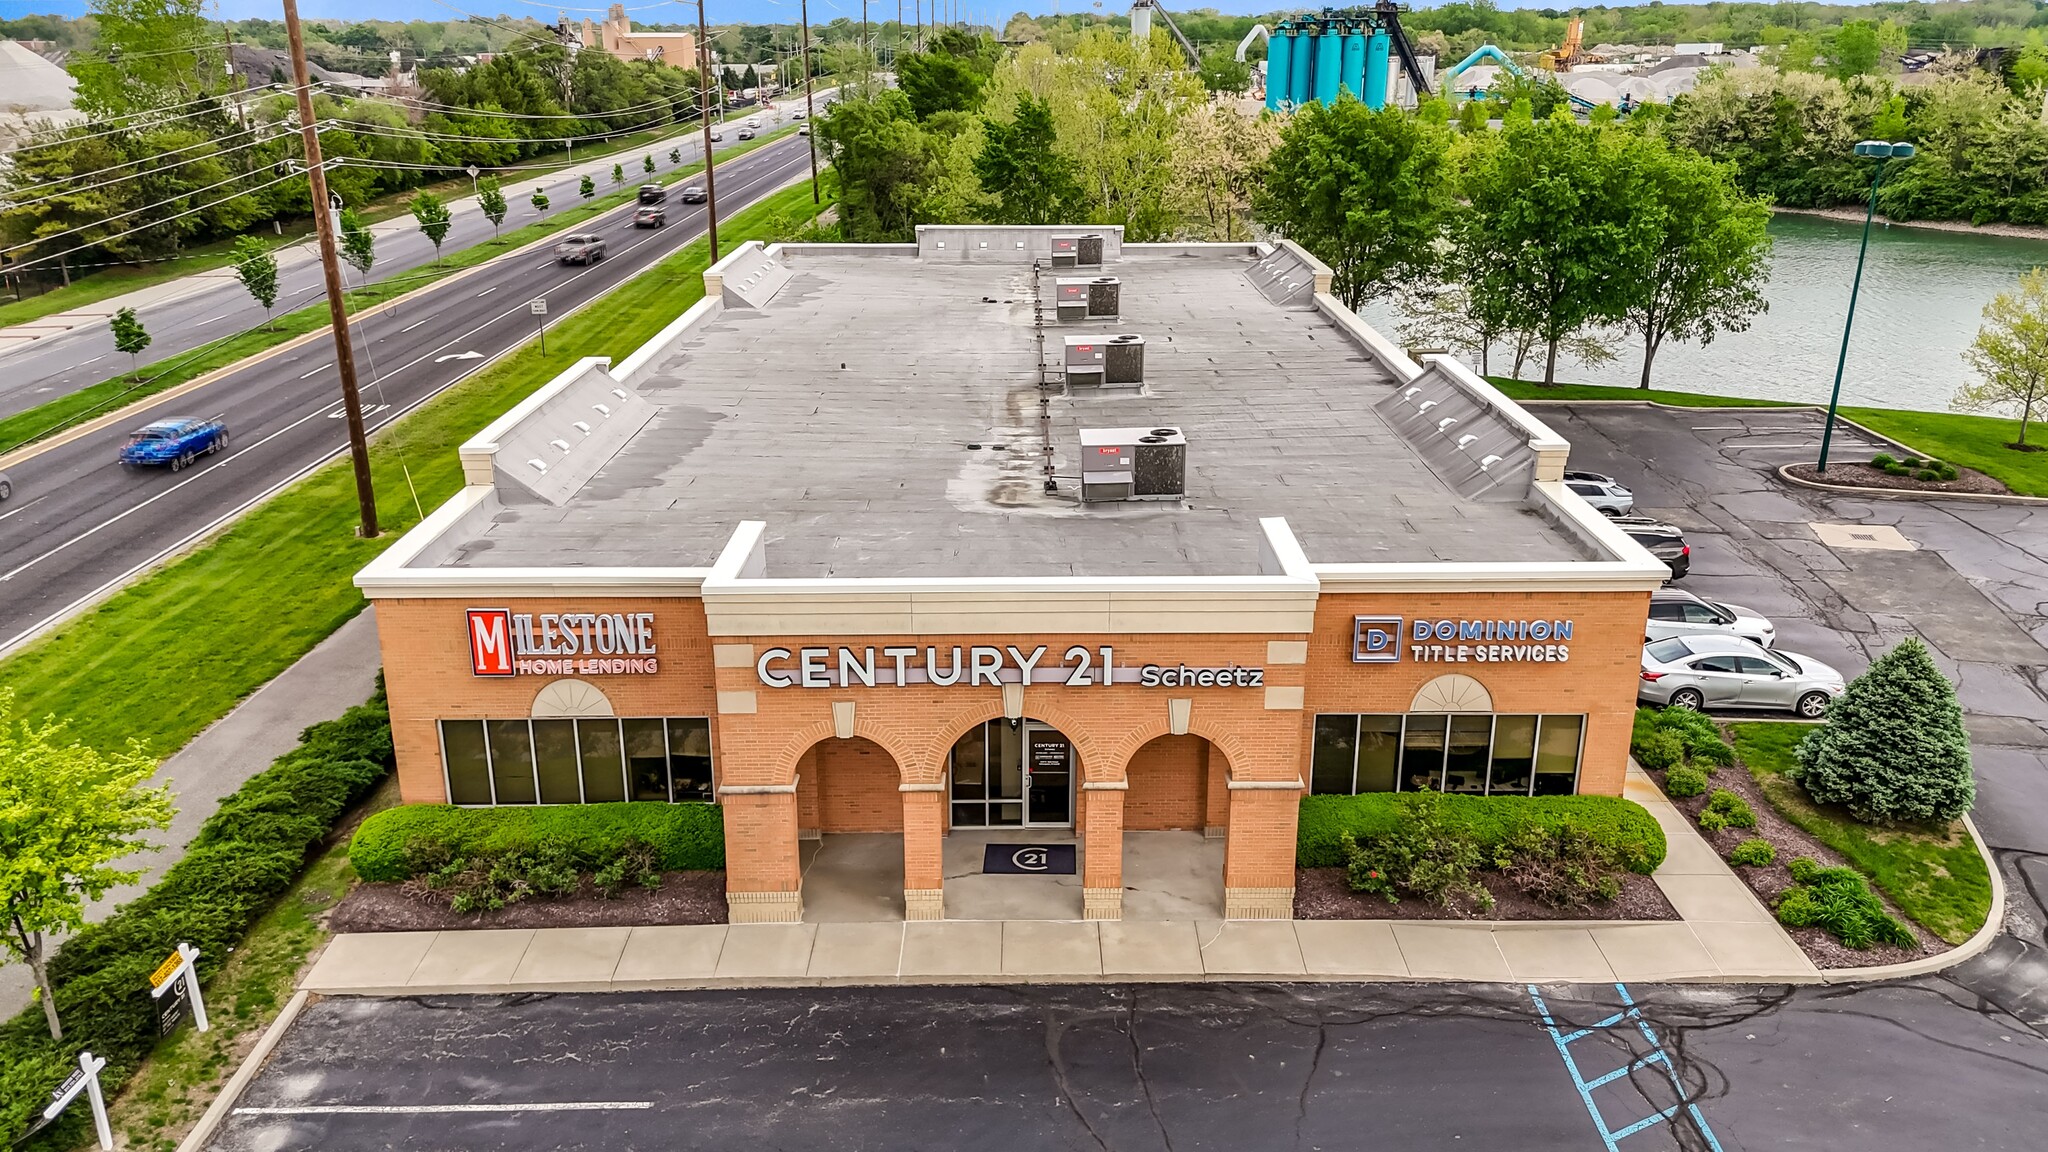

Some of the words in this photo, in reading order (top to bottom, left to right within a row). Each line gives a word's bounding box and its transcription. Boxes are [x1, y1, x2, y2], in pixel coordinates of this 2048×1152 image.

[1412, 619, 1574, 640] DOMINION
[471, 613, 656, 671] MILESTONE
[1411, 645, 1469, 662] TITLE
[1475, 644, 1570, 662] SERVICES
[519, 659, 575, 675] HOME
[579, 658, 658, 675] LENDING
[757, 646, 1047, 688] CENTURY
[1064, 645, 1113, 686] 21
[1140, 663, 1264, 687] Scheetz
[1024, 853, 1047, 864] 21
